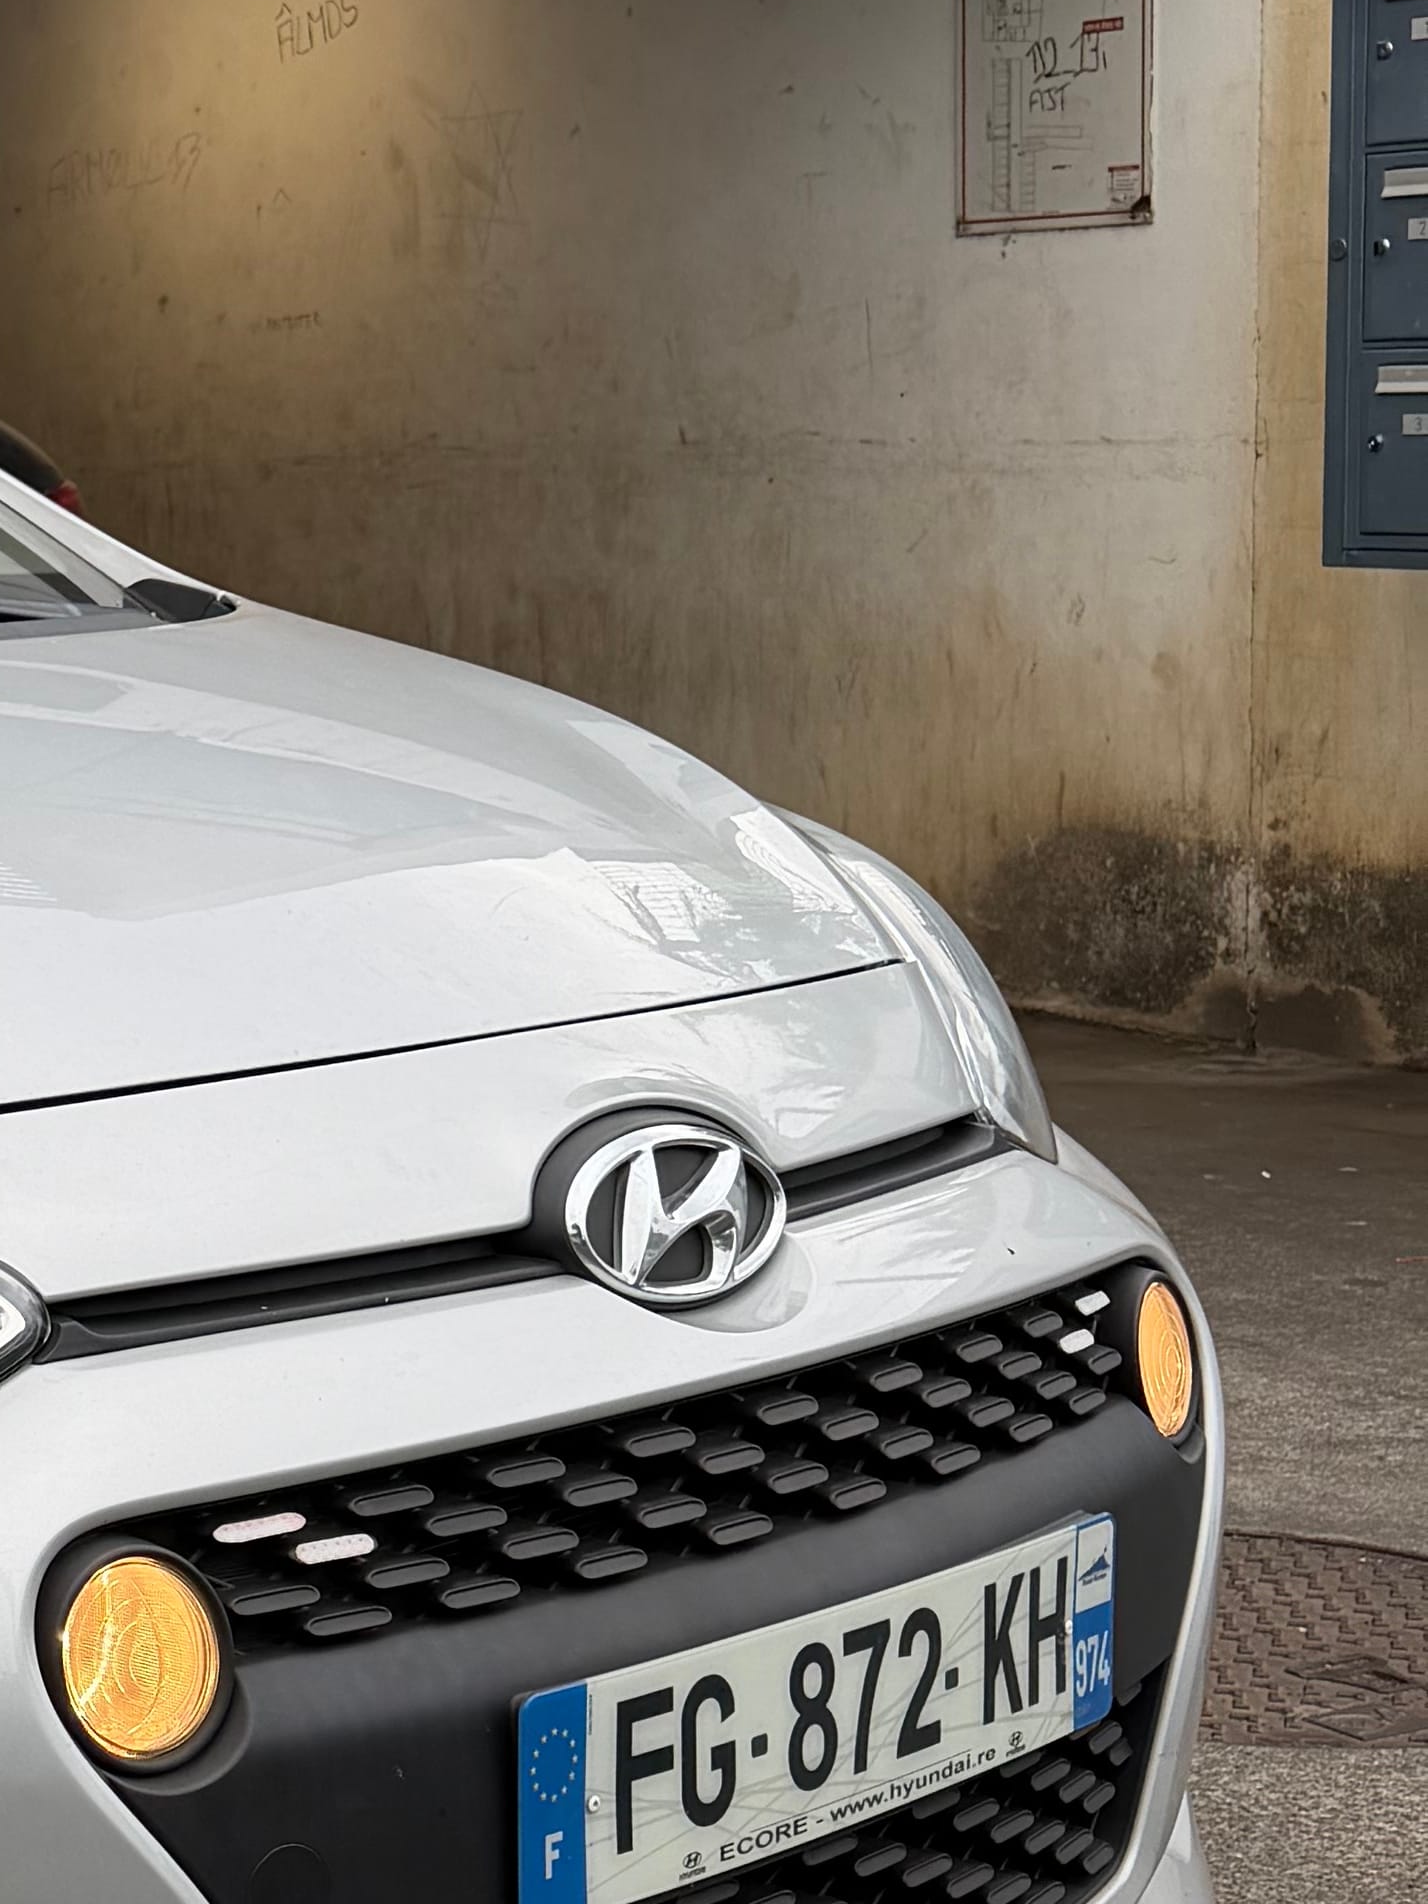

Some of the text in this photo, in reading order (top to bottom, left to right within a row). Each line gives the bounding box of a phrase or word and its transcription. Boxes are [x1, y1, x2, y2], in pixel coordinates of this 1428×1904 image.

[1076, 1630, 1111, 1698] 974
[719, 1816, 808, 1863] ECORE
[829, 1747, 996, 1822] www.hyundai.re
[545, 1830, 564, 1881] F
